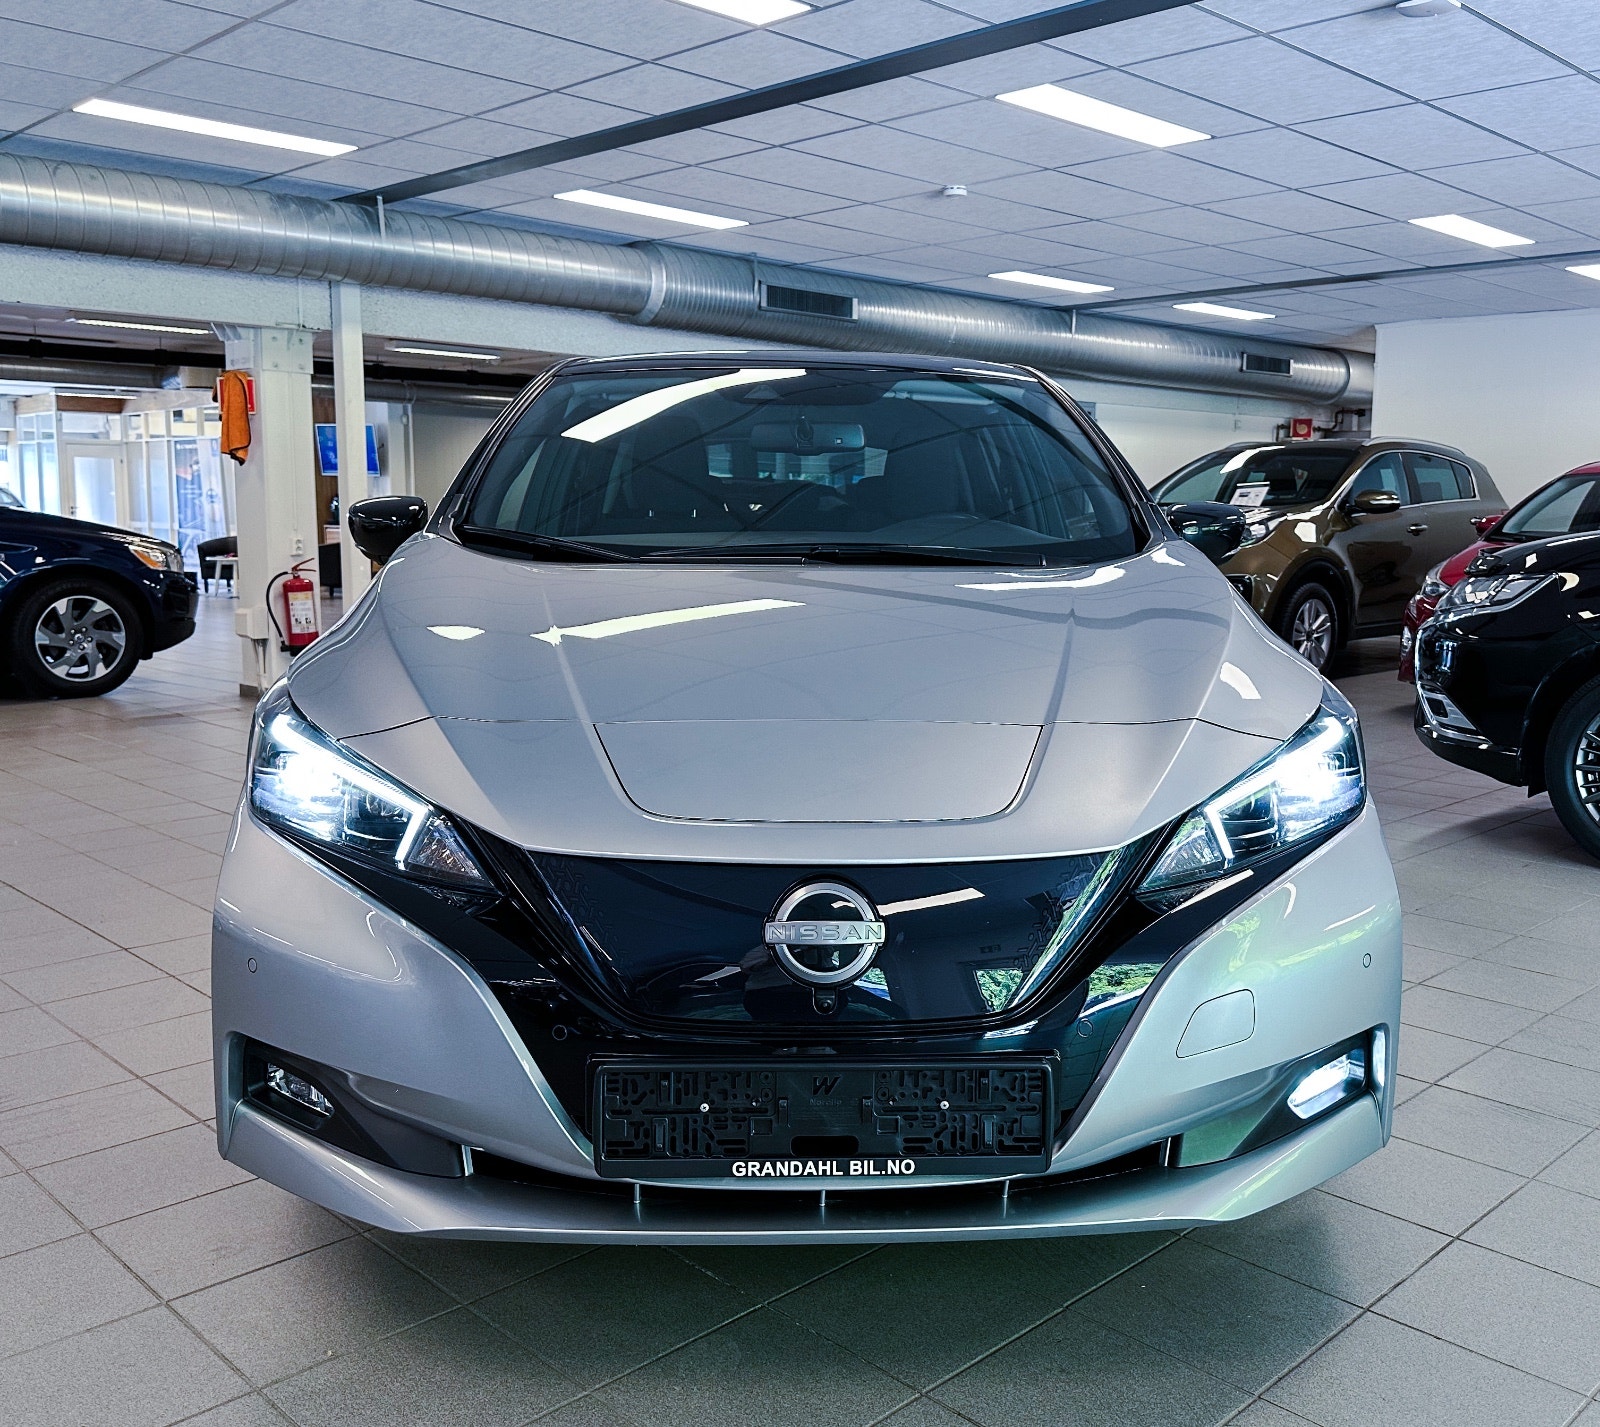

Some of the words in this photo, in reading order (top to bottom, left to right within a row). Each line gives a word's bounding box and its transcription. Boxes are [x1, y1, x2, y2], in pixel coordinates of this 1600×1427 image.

[768, 925, 882, 940] NISSAN
[732, 1160, 843, 1177] GRANDAHL
[849, 1159, 916, 1175] BIL.NO
